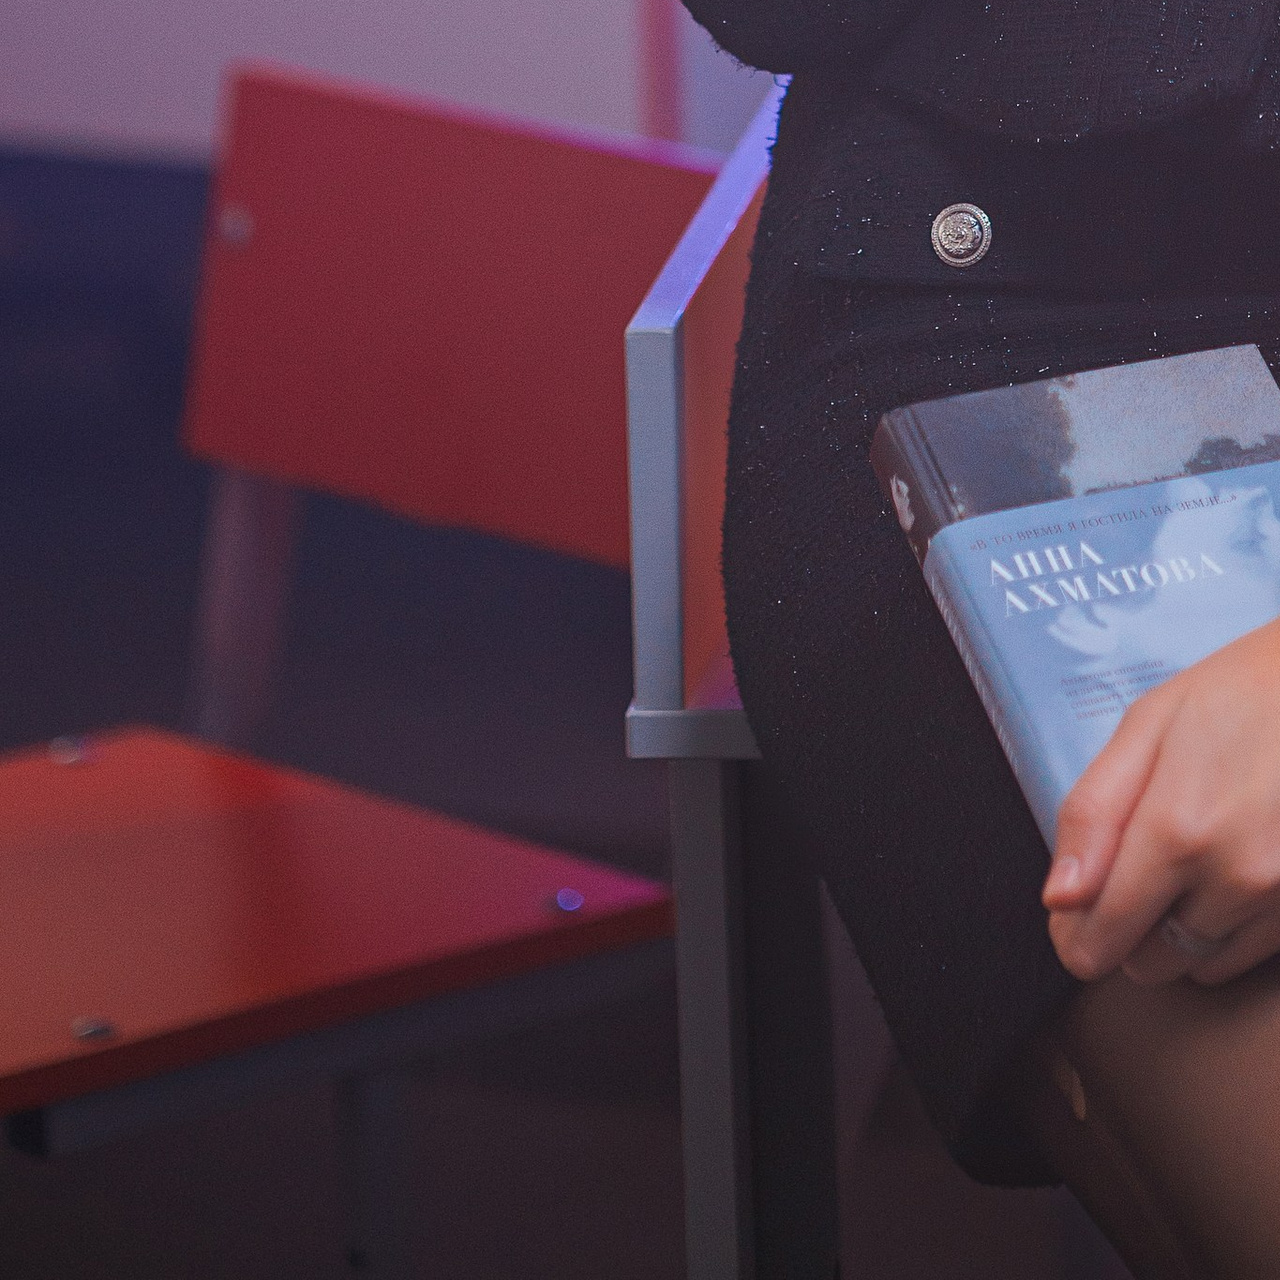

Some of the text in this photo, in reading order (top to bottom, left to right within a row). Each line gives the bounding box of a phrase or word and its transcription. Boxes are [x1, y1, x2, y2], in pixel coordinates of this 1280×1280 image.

[993, 534, 1013, 547] ТО
[1016, 523, 1062, 542] ВРЕМЯ
[1068, 520, 1078, 532] Я
[1081, 507, 1148, 530] ГОСТИЛА
[1152, 503, 1174, 518] НА
[990, 540, 1104, 586] АННА
[1004, 552, 1225, 618] АХМАТОВА
